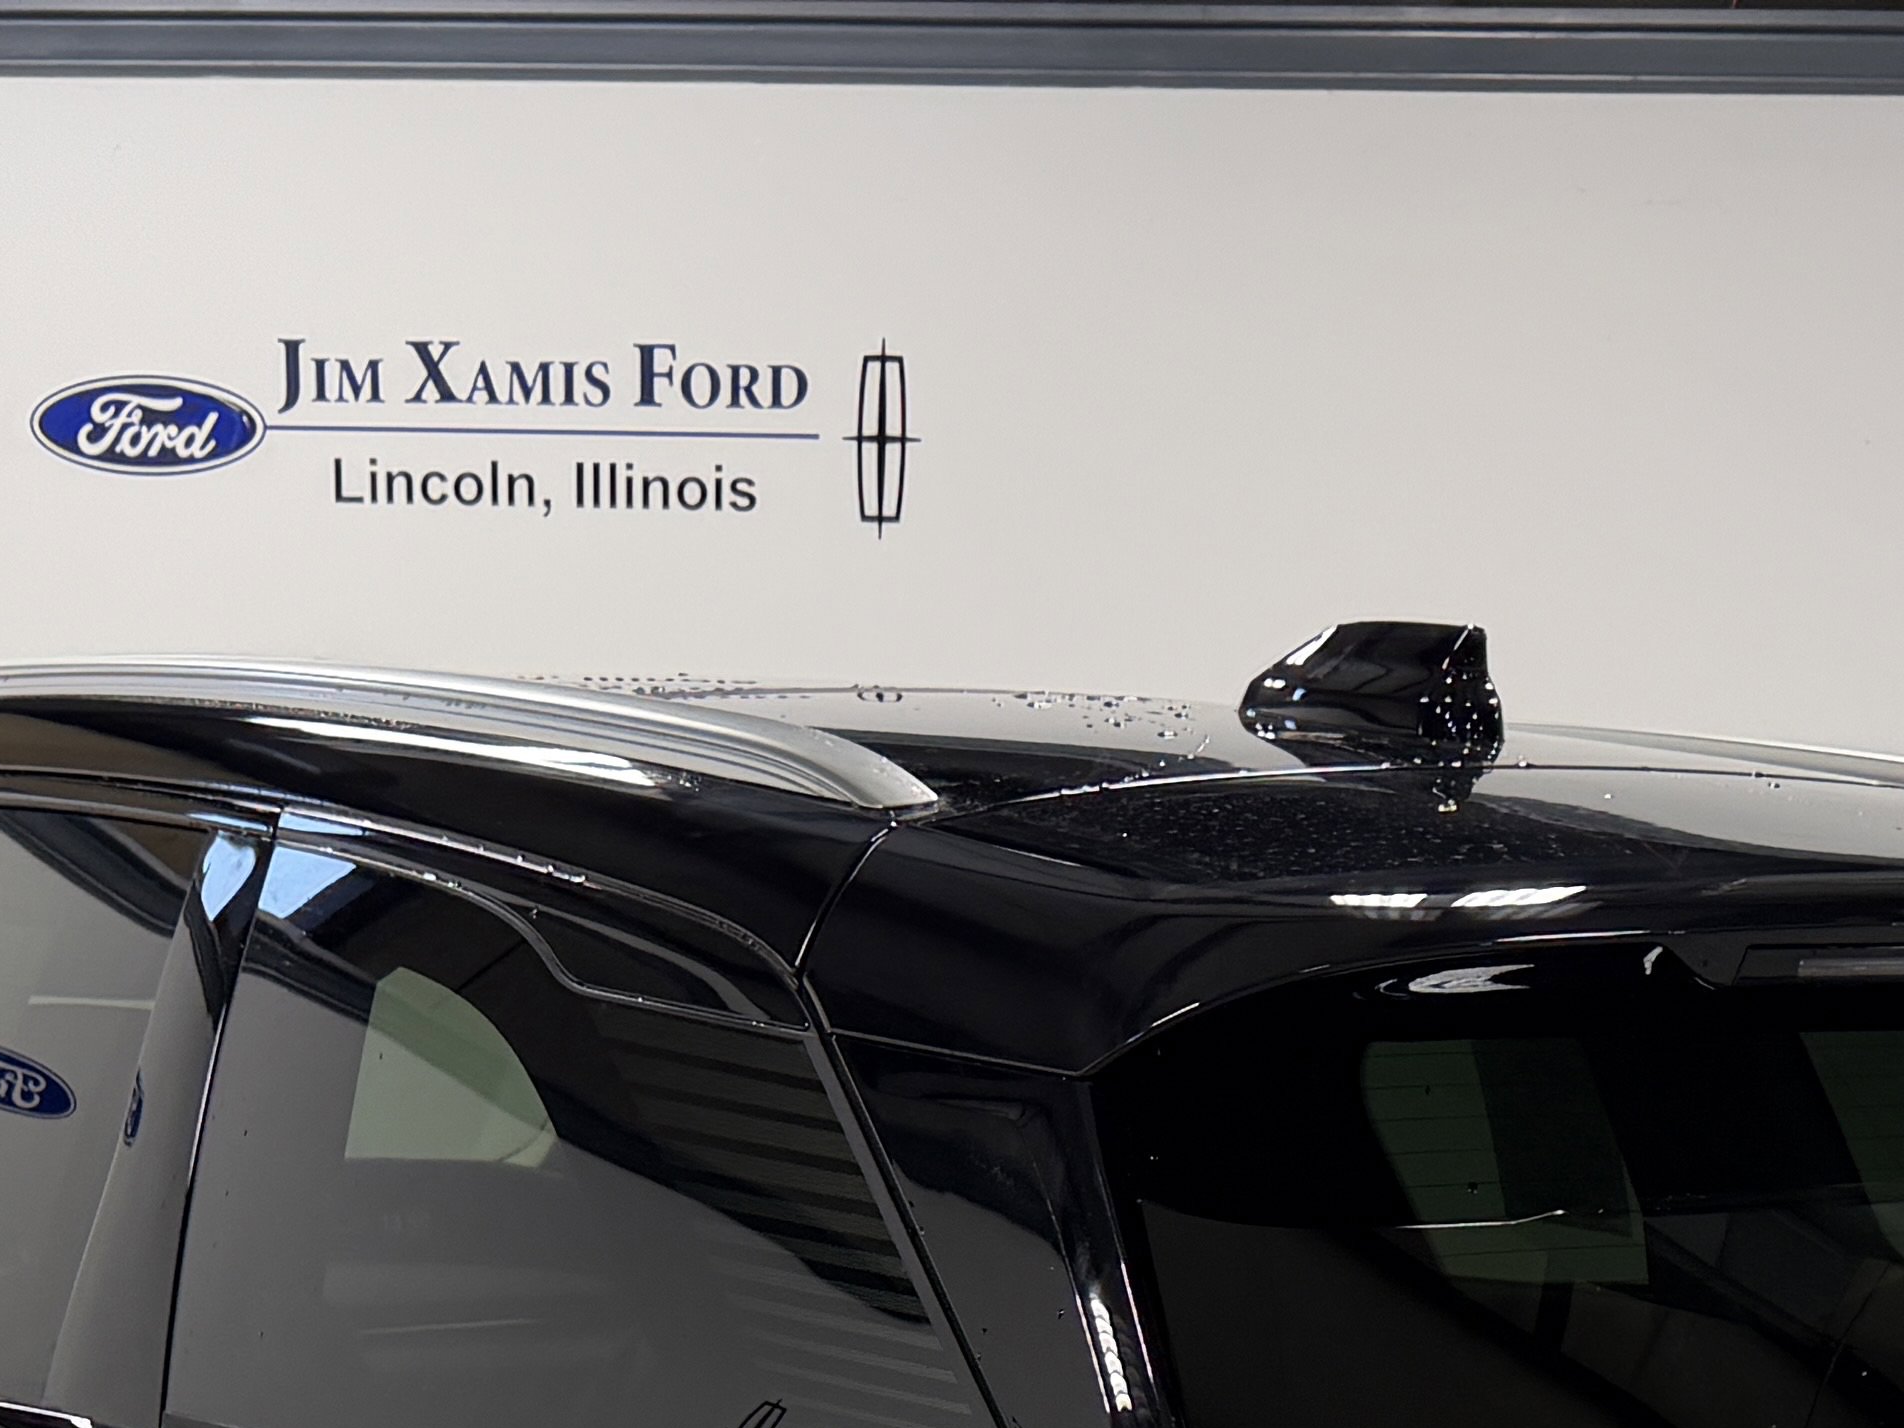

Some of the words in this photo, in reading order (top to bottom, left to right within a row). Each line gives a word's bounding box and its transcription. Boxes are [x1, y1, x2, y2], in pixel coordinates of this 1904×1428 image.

[277, 338, 384, 415] JIM
[404, 340, 611, 407] XAMIS
[632, 343, 809, 410] FORD
[77, 391, 218, 460] Ford
[333, 457, 552, 517] Lincoln,
[575, 461, 757, 513] Illinois
